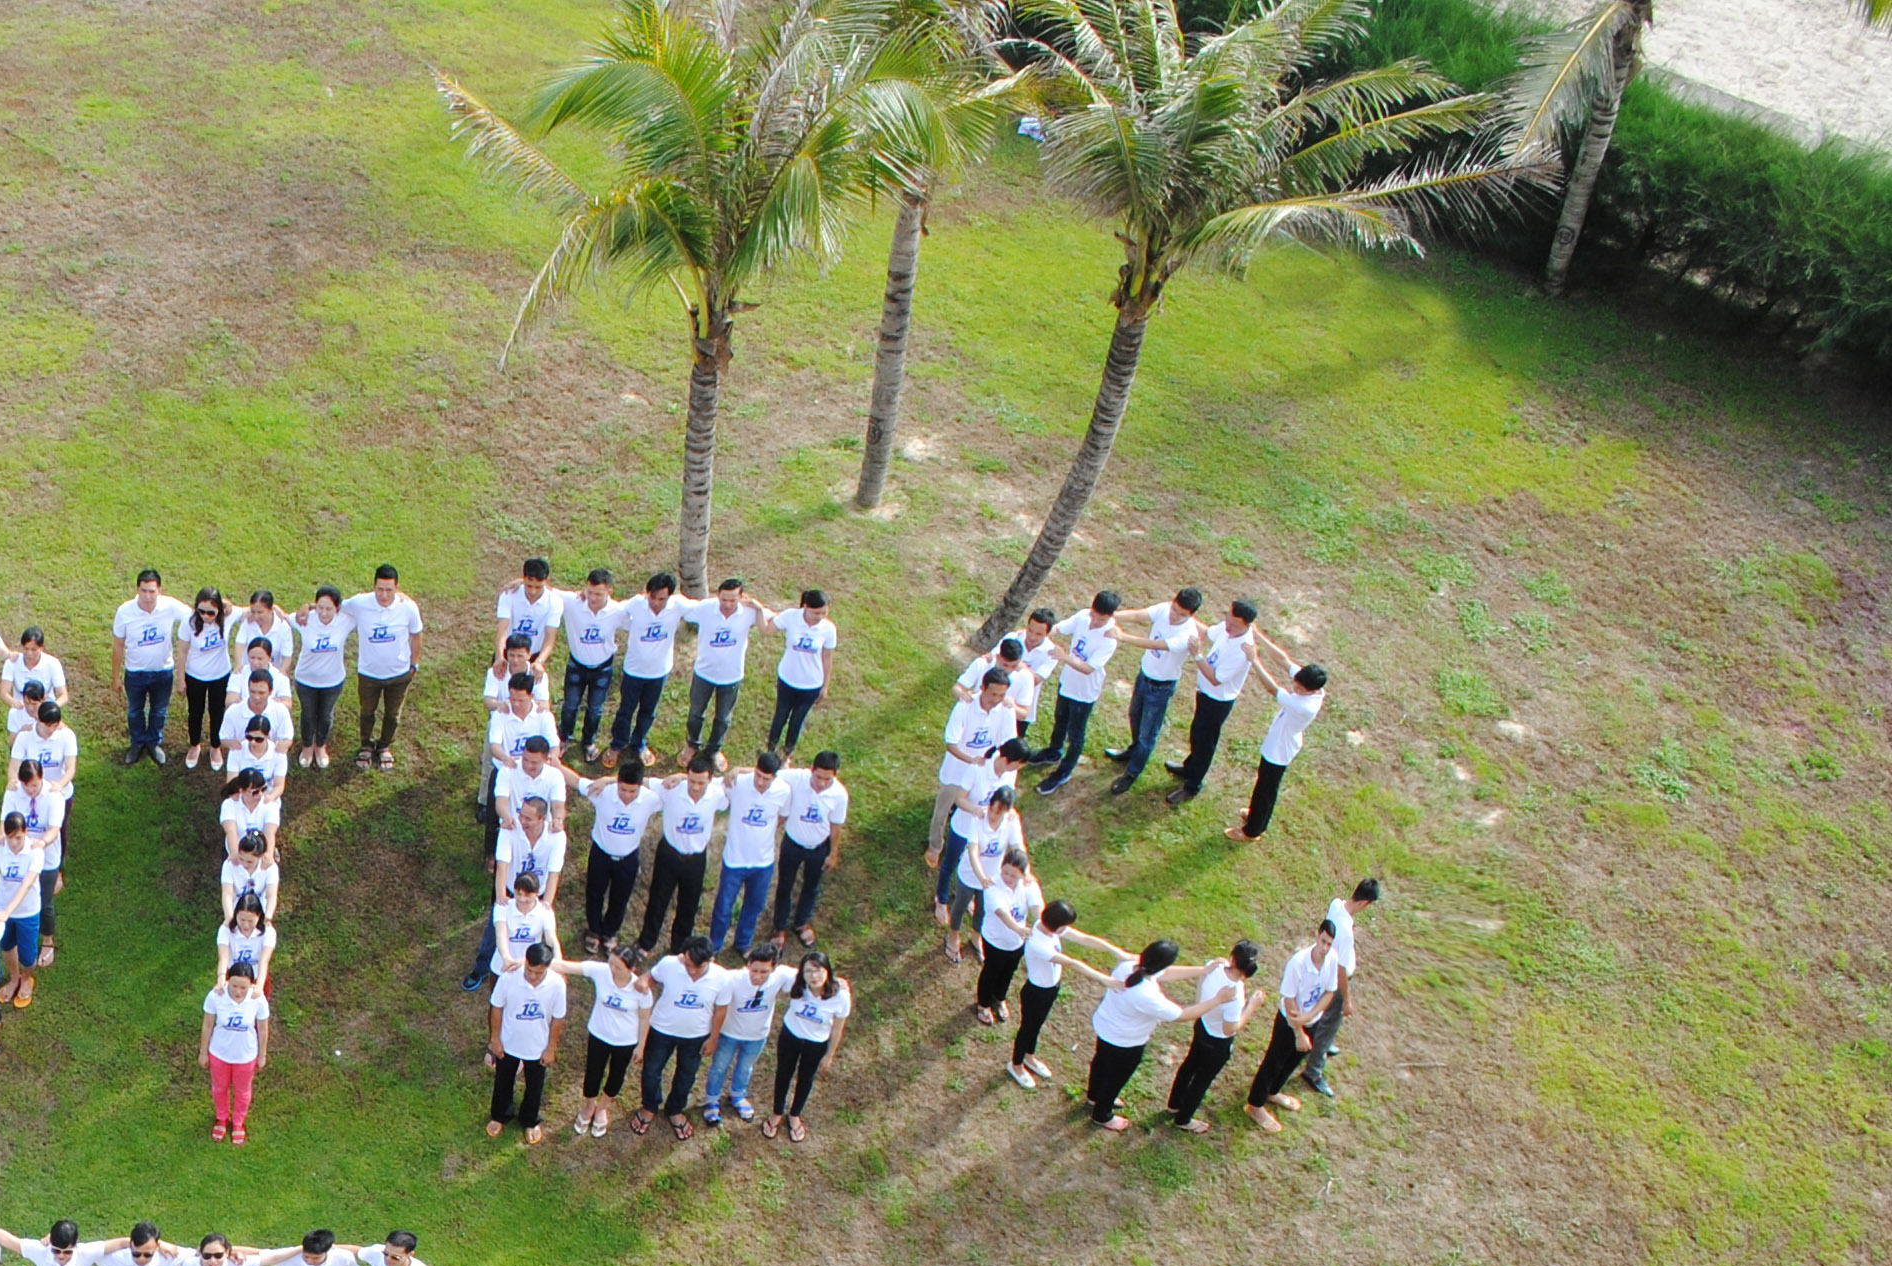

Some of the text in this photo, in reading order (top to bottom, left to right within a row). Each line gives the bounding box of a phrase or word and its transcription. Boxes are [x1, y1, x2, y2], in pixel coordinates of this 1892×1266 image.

[517, 619, 533, 632] 15
[646, 625, 662, 638] 15
[142, 627, 157, 641] 15
[372, 626, 388, 639] 15
[585, 628, 600, 640] 15
[715, 630, 731, 643] 15
[204, 633, 218, 648] 15
[314, 636, 329, 649] 15
[972, 730, 988, 744] 15
[747, 808, 763, 820] 15
[612, 817, 630, 830] 15
[681, 816, 699, 828] 15
[606, 995, 622, 1007] 15
[681, 993, 699, 1005] 15
[522, 1003, 538, 1015] 15
[802, 1005, 818, 1017] 15
